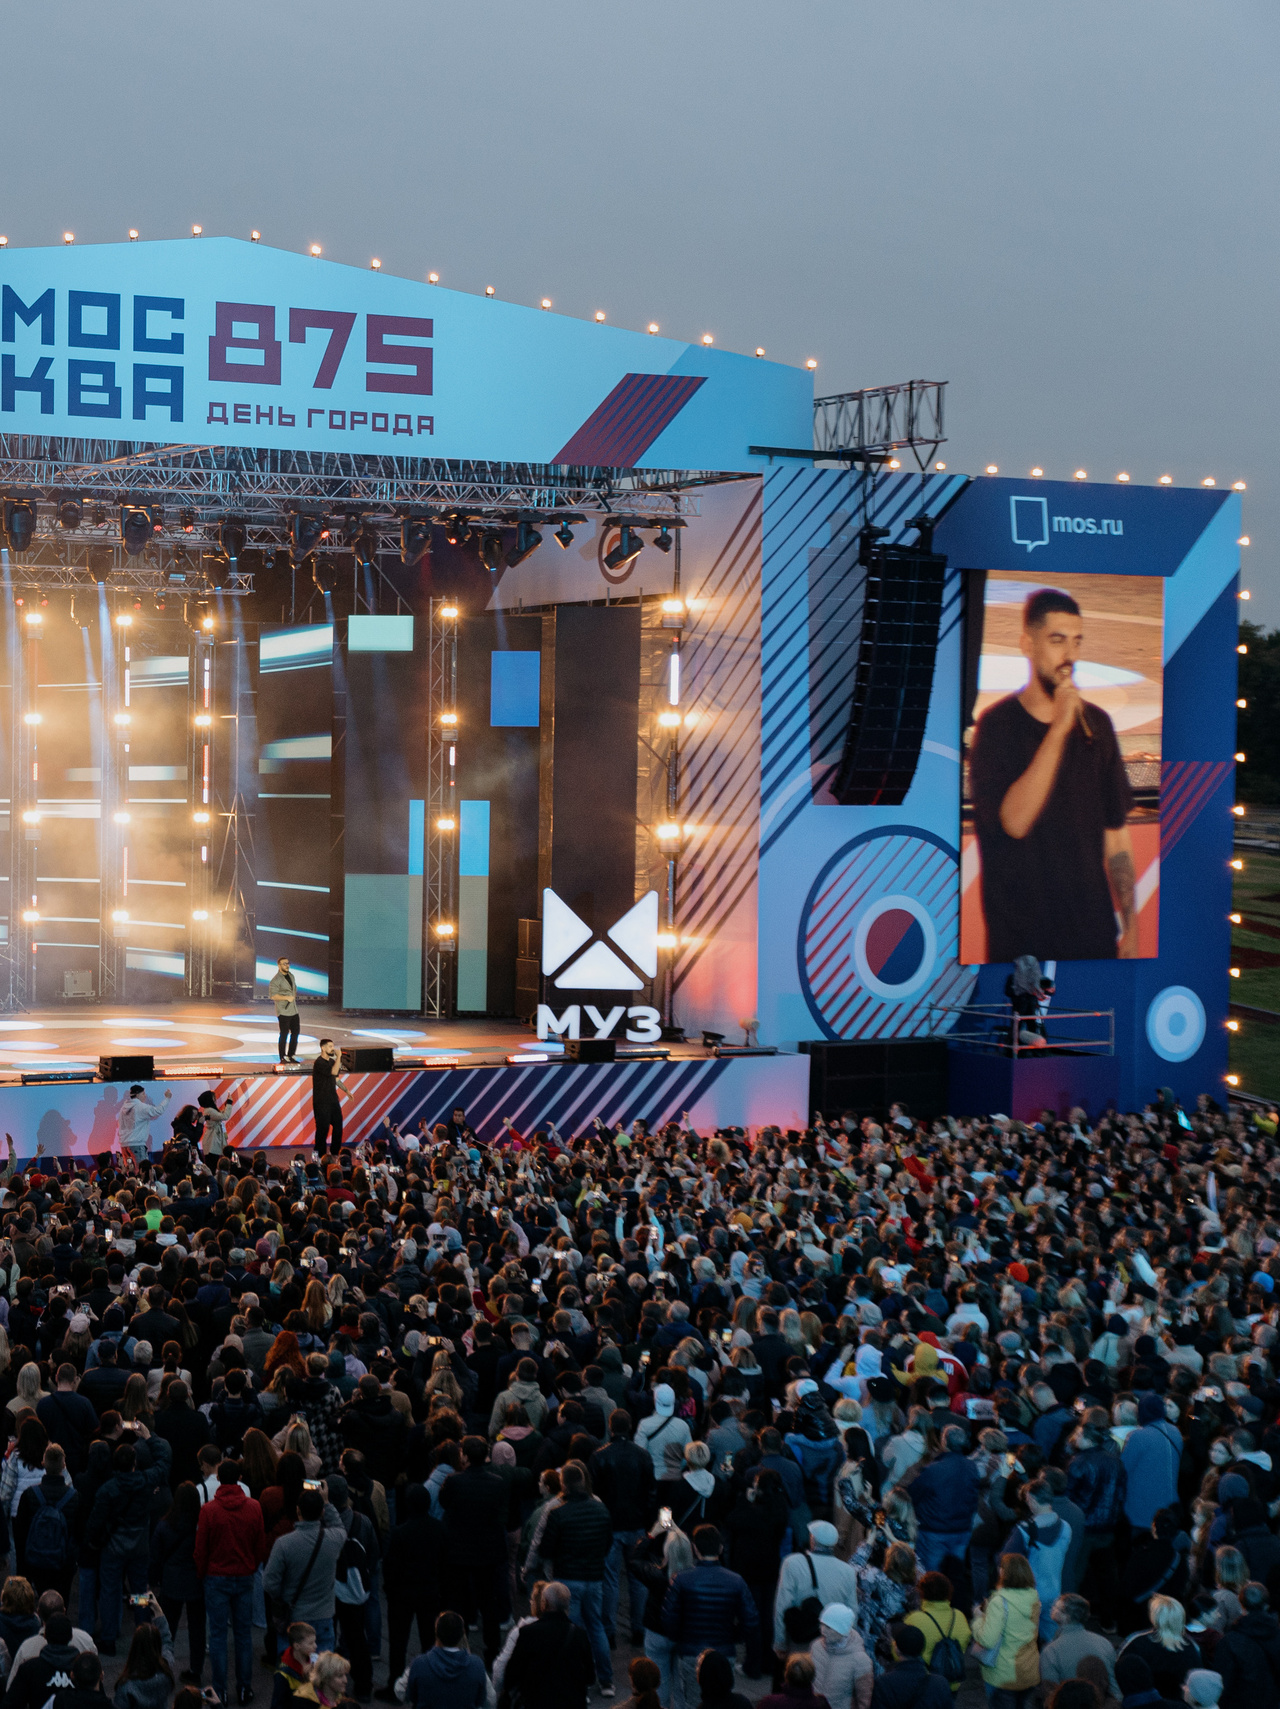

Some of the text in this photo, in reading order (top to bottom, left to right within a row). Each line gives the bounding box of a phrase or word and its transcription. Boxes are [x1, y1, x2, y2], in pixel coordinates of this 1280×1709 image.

[2, 284, 185, 355] МОС
[208, 301, 434, 396] 875
[1, 353, 184, 422] КВА
[207, 402, 435, 437] ДЕНЬ ГОРОДА
[1052, 516, 1123, 536] mos.ru
[536, 1003, 662, 1043] МУЗ
